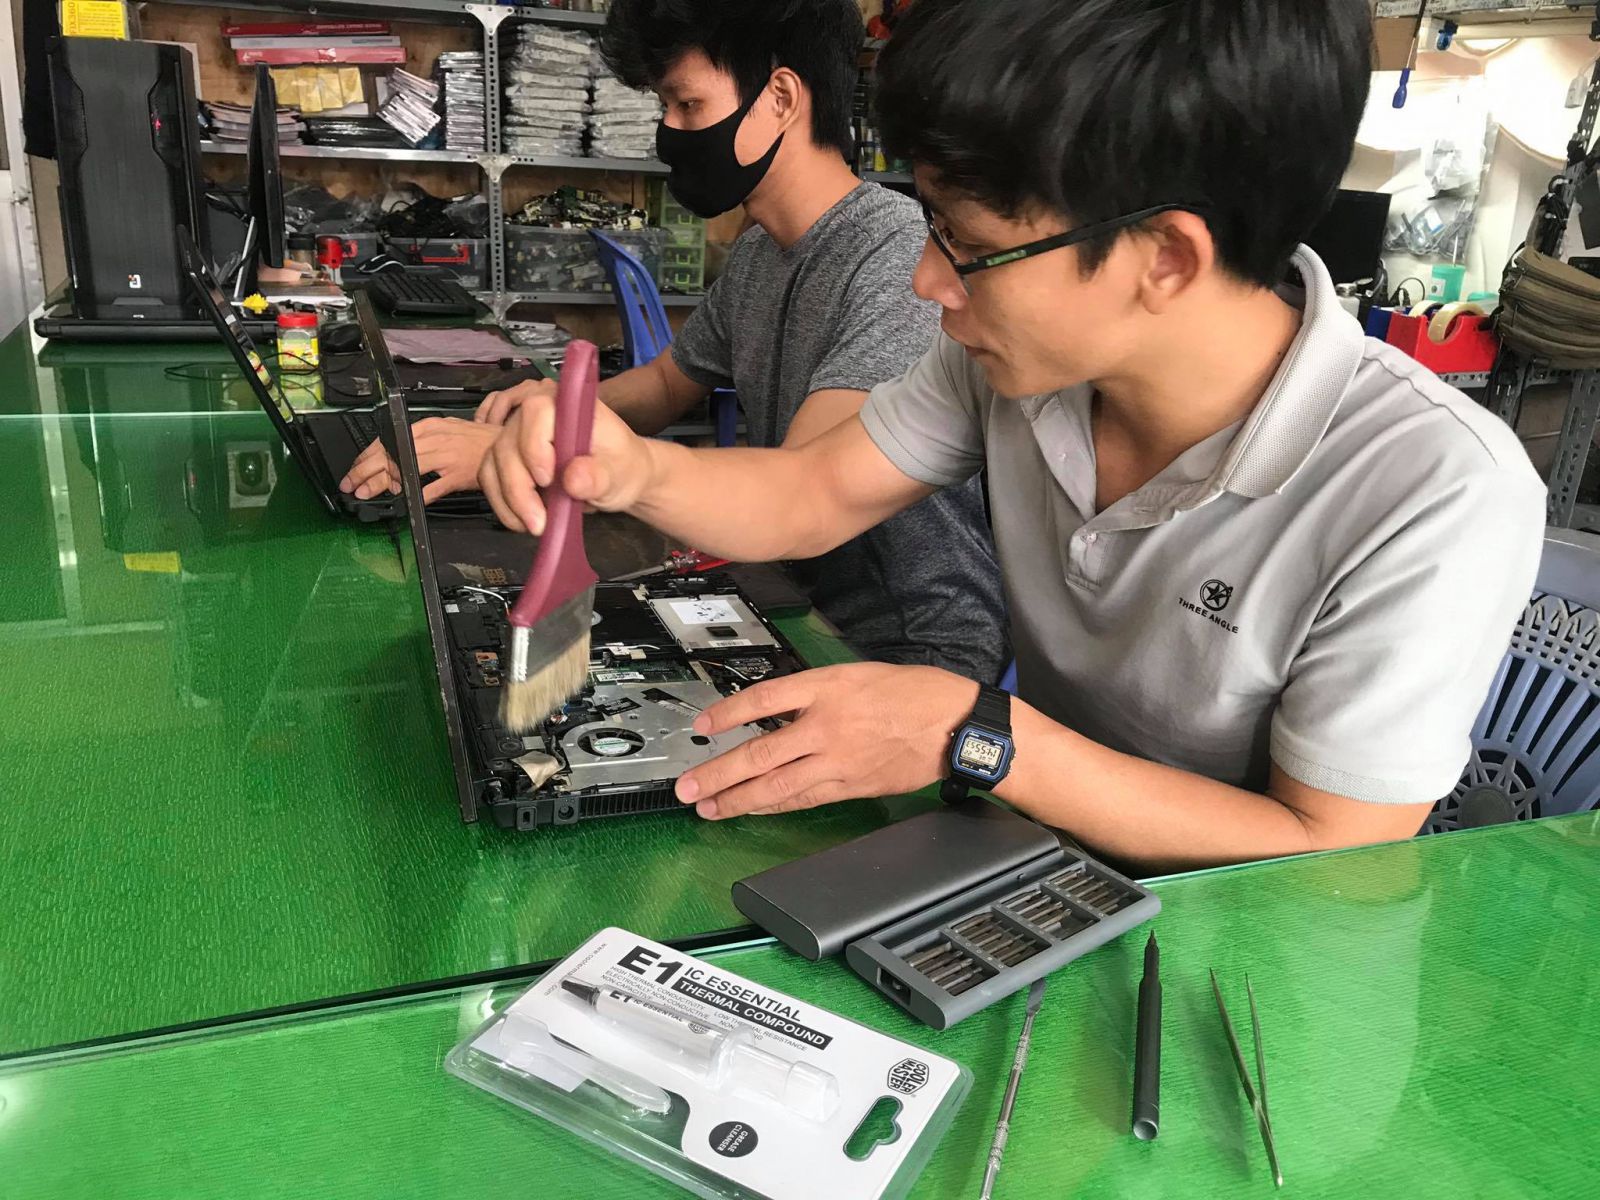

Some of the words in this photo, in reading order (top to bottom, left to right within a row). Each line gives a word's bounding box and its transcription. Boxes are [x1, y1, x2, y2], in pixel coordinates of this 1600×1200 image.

[1178, 597, 1208, 617] THREE
[1208, 613, 1239, 634] ANGLE
[605, 970, 651, 993] ELECTRICALLY
[617, 945, 683, 985] E1
[610, 966, 628, 977] HIGH
[628, 973, 656, 989] THERMAL
[657, 987, 706, 1010] CONDUCTIVITY
[684, 967, 705, 981] IC
[705, 975, 801, 1021] ESSENTIAL
[679, 980, 741, 1013] THERMAL
[743, 1008, 826, 1045] COMPOUND
[713, 1012, 730, 1021] LOW
[763, 1031, 808, 1051] RESISTANCE
[890, 1059, 917, 1089] MASTER
[900, 1063, 927, 1093] COOLER
[717, 1124, 743, 1151] CLEANSER
[727, 1130, 749, 1153] GREASE
